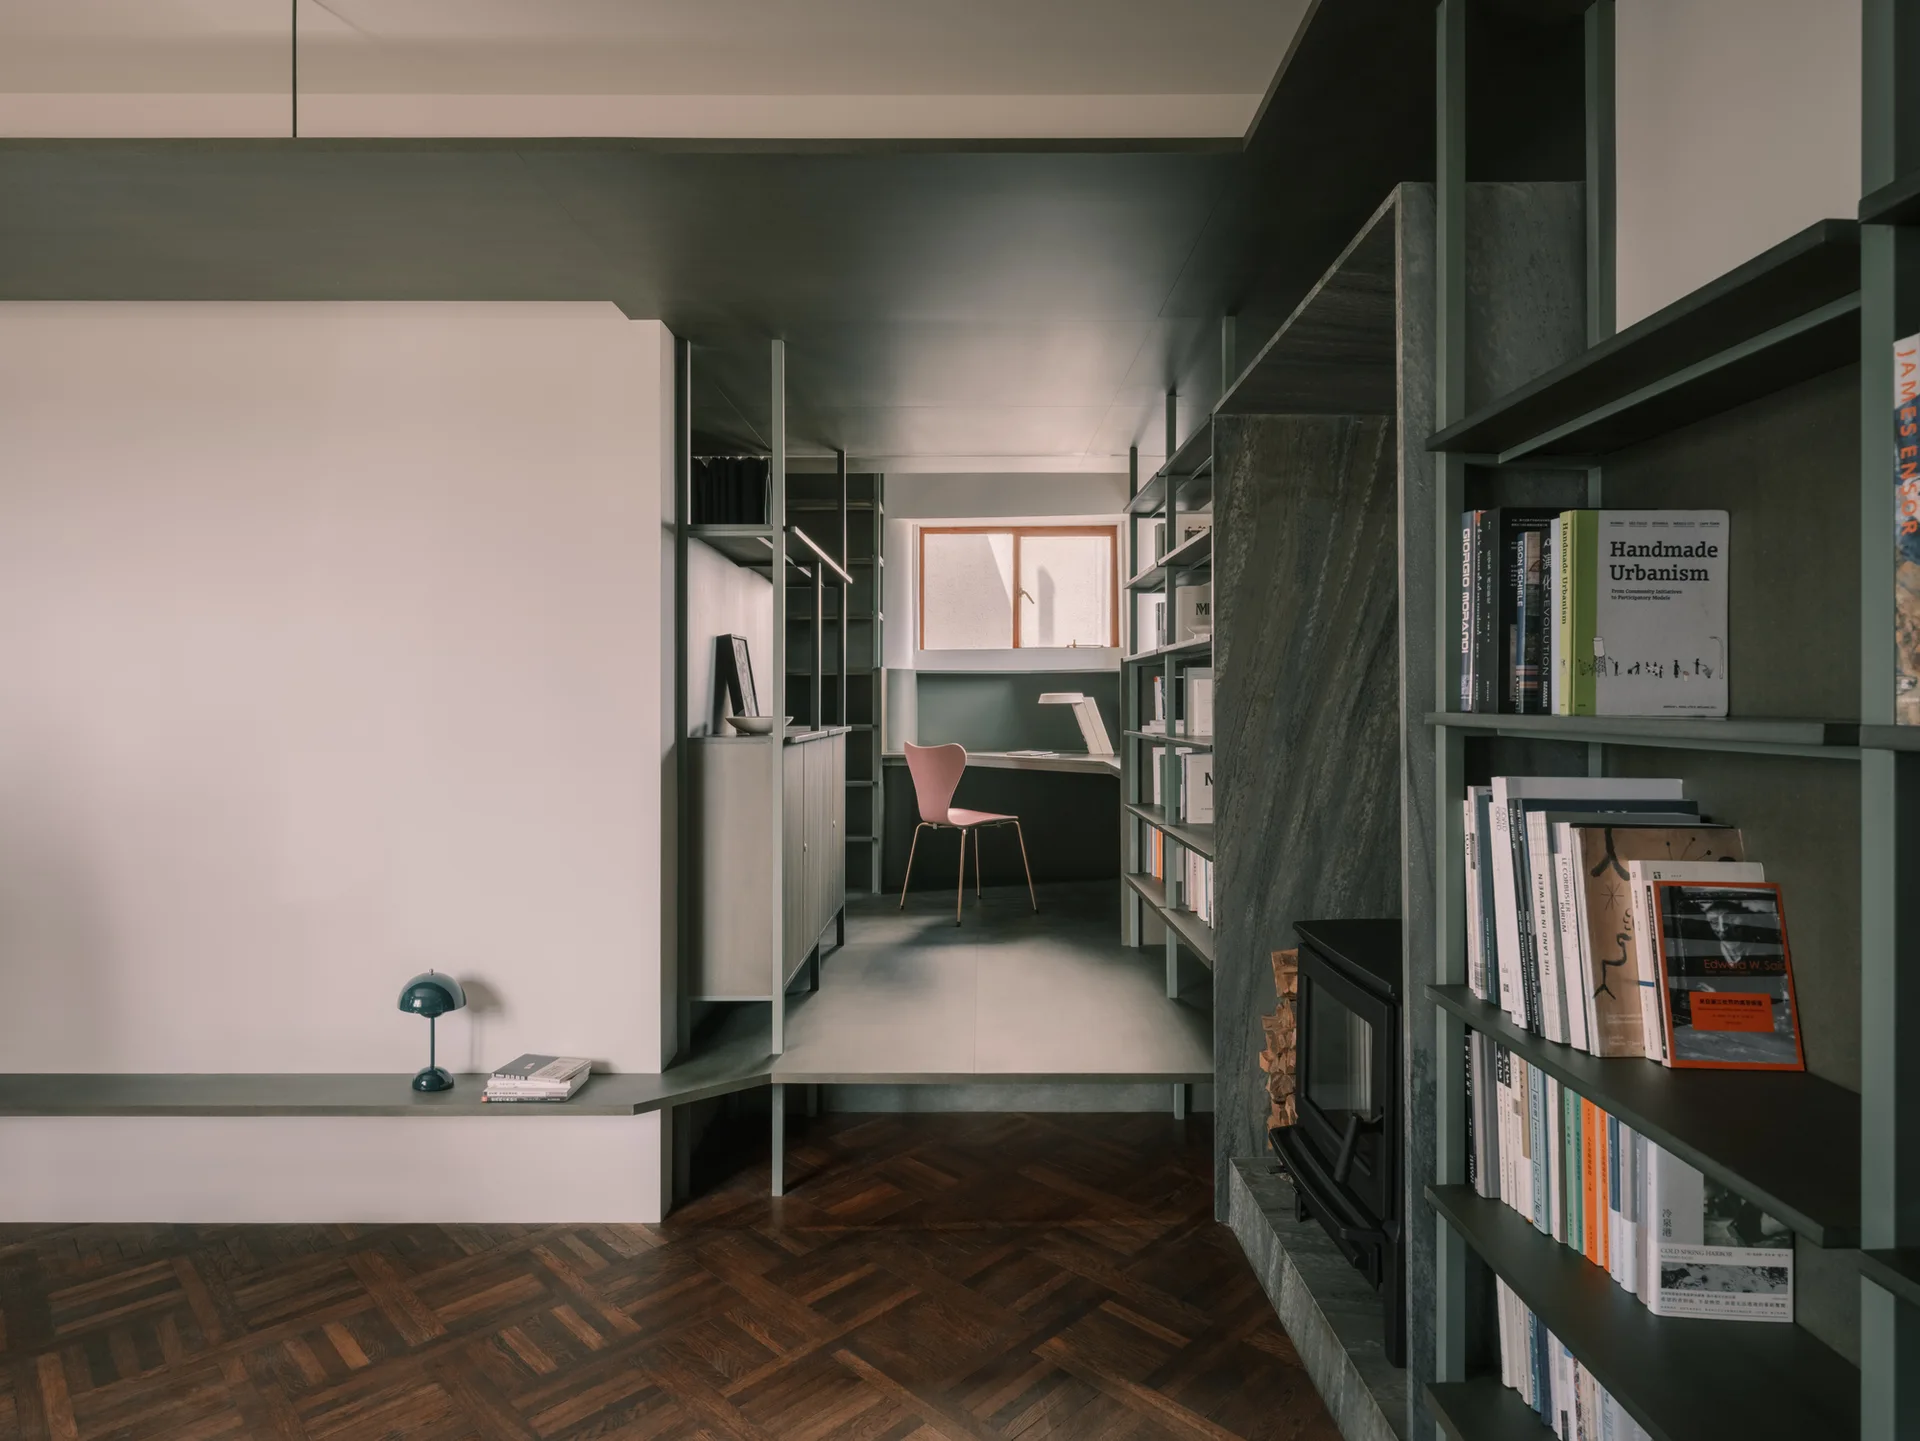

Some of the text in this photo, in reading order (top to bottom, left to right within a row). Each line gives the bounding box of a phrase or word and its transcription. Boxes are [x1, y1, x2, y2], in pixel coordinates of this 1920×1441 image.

[1896, 349, 1918, 536] JAMES ENSOR
[1610, 541, 1718, 558] Handmade
[1610, 564, 1709, 581] Urbanism
[1461, 528, 1472, 653] GIORGIO MORANDI
[1562, 857, 1571, 913] LE CORBUSIER
[1703, 959, 1747, 970] Edward
[1662, 1208, 1672, 1237] 冷泉港
